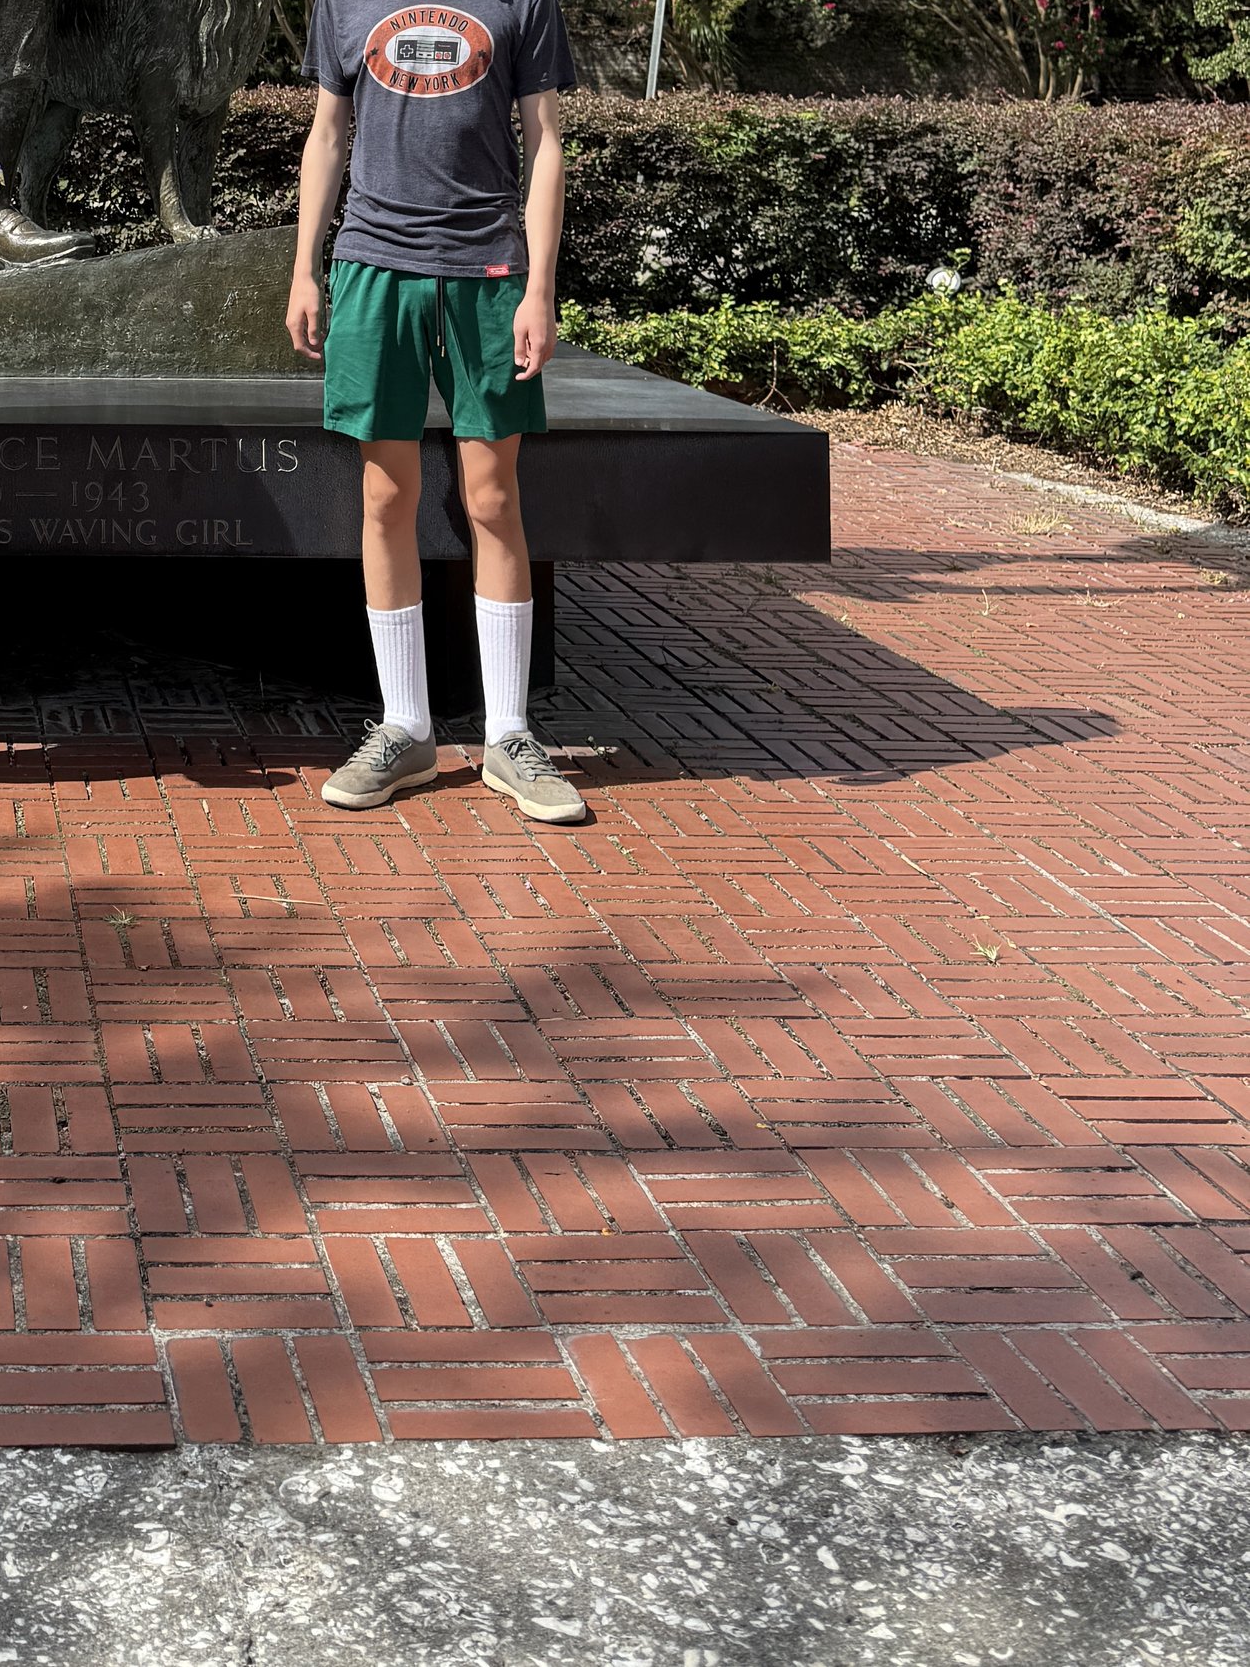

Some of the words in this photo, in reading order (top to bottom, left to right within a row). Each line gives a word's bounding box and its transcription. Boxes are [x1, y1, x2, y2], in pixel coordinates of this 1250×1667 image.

[389, 10, 469, 32] NINTENDO
[390, 70, 418, 91] NEW
[424, 73, 460, 91] YORK
[86, 435, 299, 474] MARTUS
[71, 481, 151, 513] 1943
[30, 518, 158, 546] WAVING
[175, 519, 254, 547] GIRL
